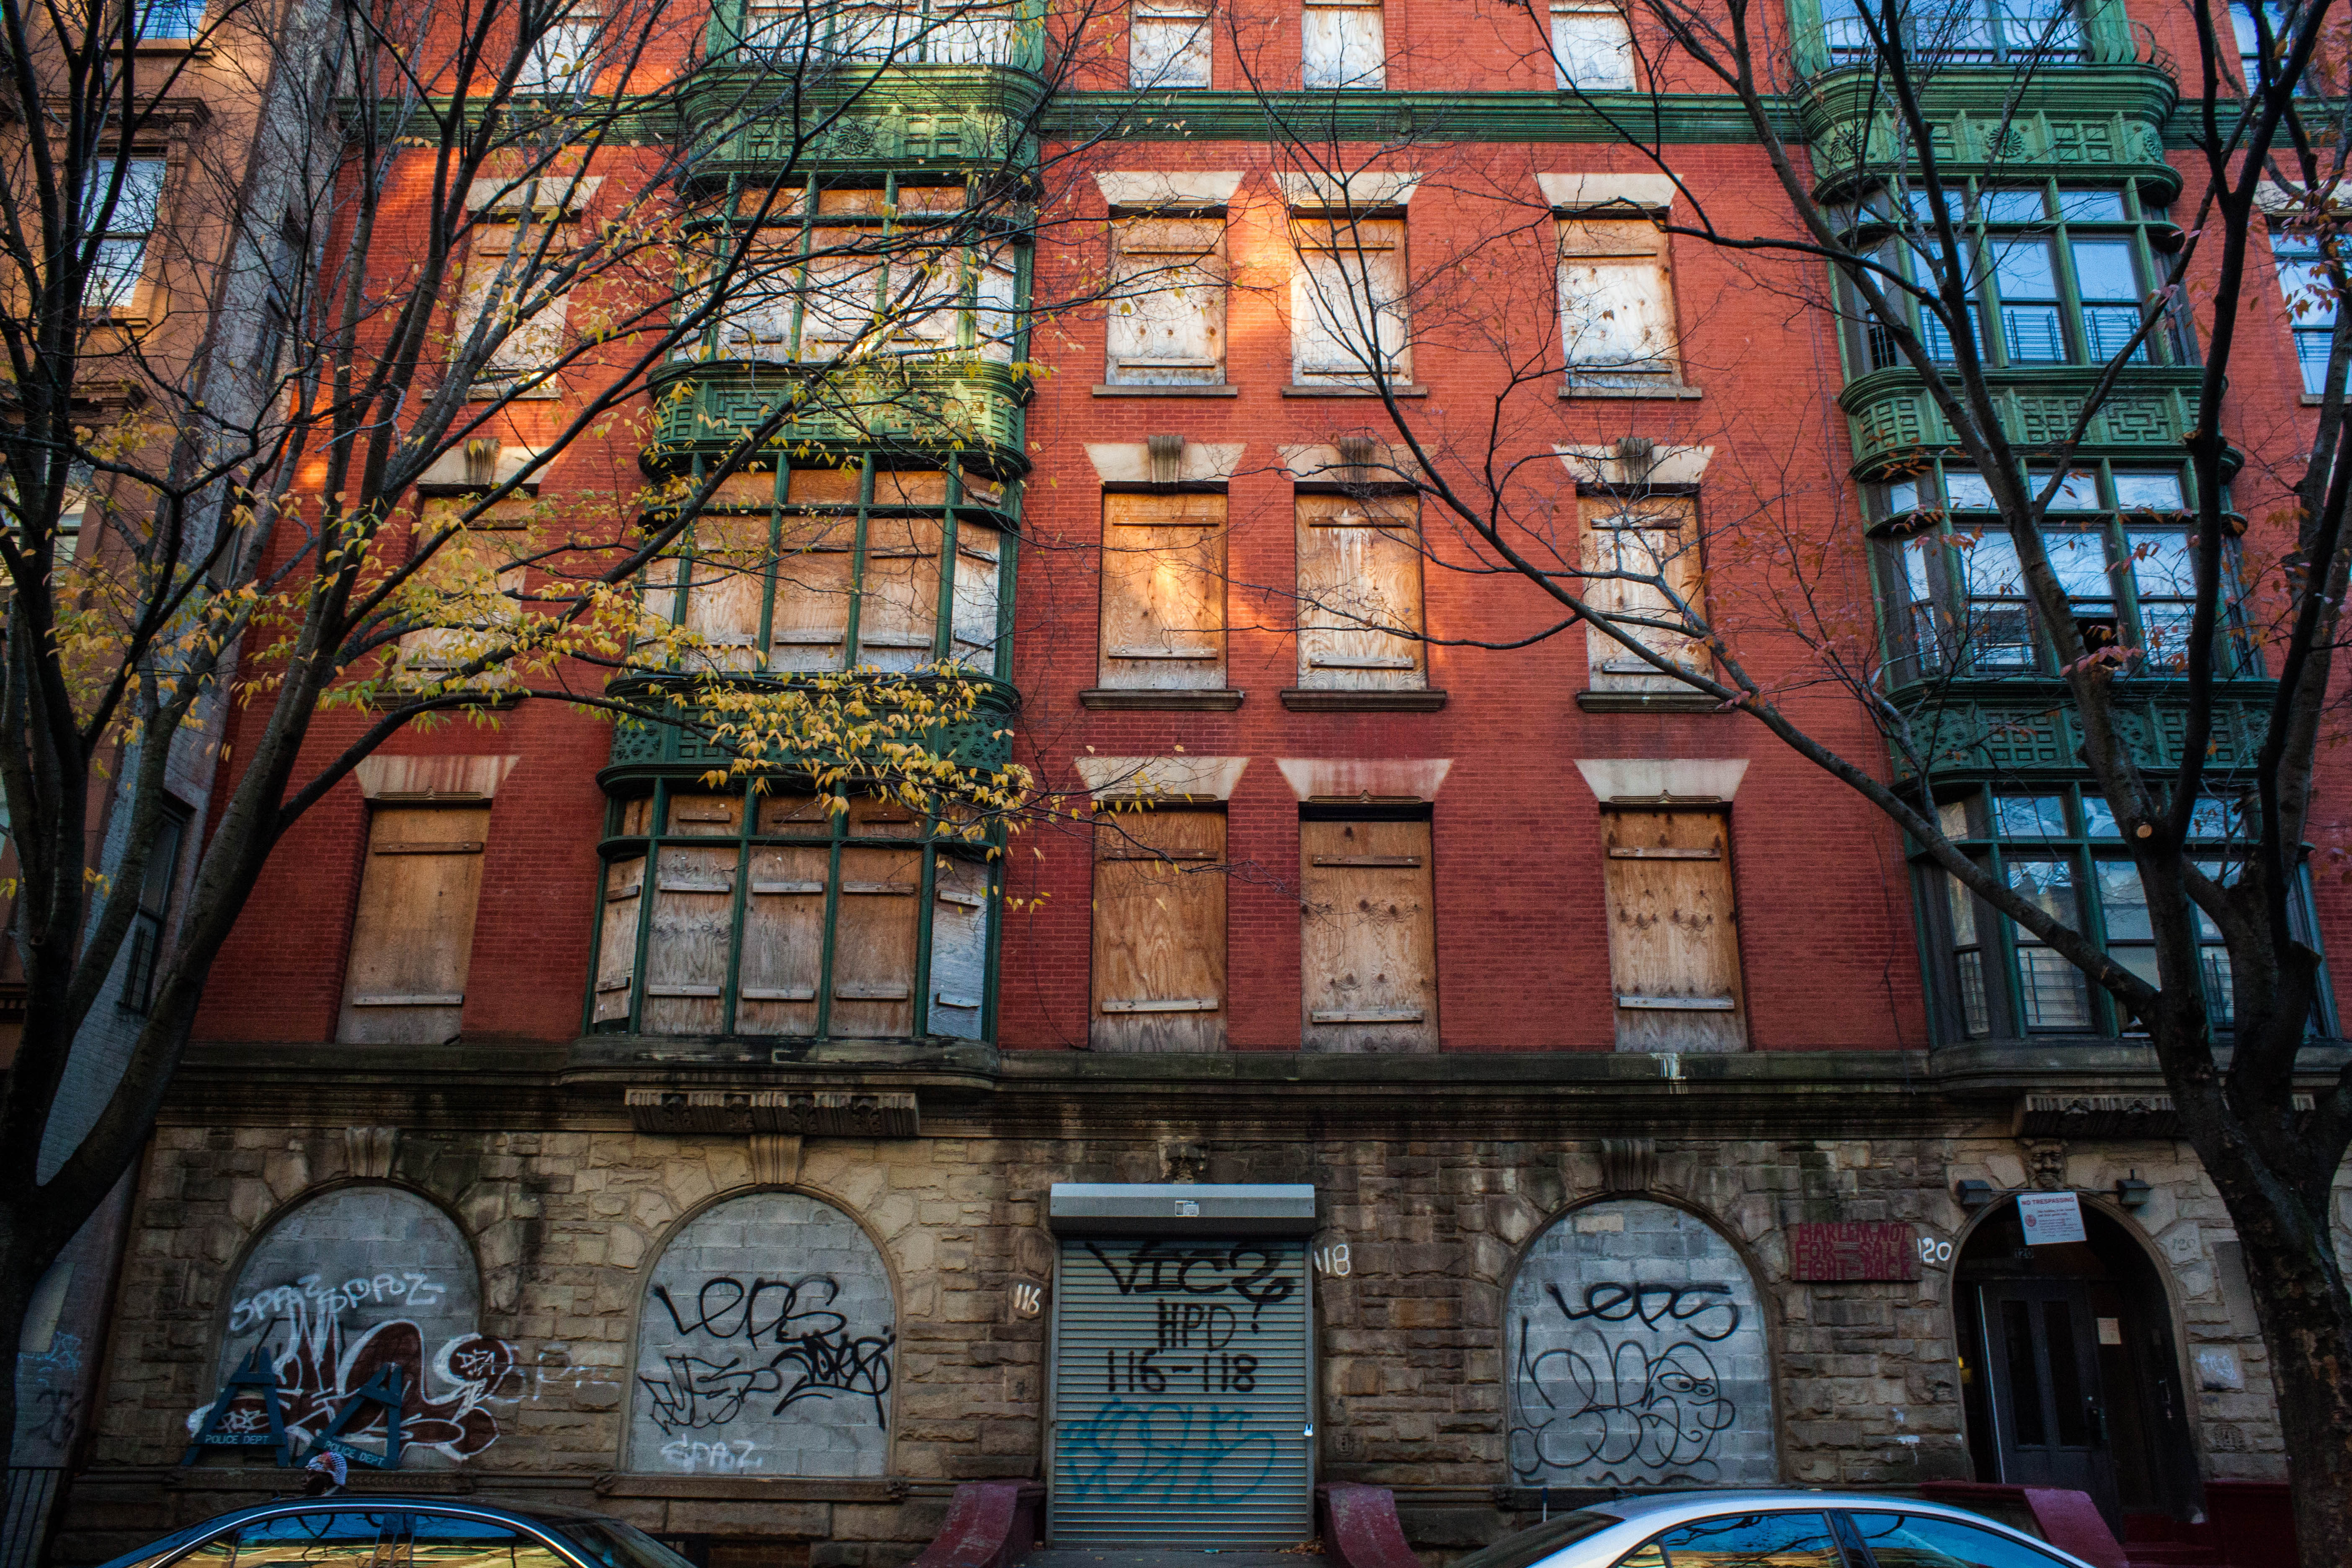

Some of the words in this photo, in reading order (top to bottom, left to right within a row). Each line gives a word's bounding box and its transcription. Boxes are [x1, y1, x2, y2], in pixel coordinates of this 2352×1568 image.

[1314, 1243, 1352, 1276] 118
[1917, 1237, 1952, 1264] 120
[1014, 1284, 1040, 1314] 116
[1157, 1297, 1236, 1353] HPD
[1107, 1347, 1259, 1393] 116-118
[205, 1434, 239, 1444] POLICE
[243, 1434, 270, 1444] DEPT
[324, 1440, 356, 1459] POLICE
[358, 1449, 385, 1465] DEPT
